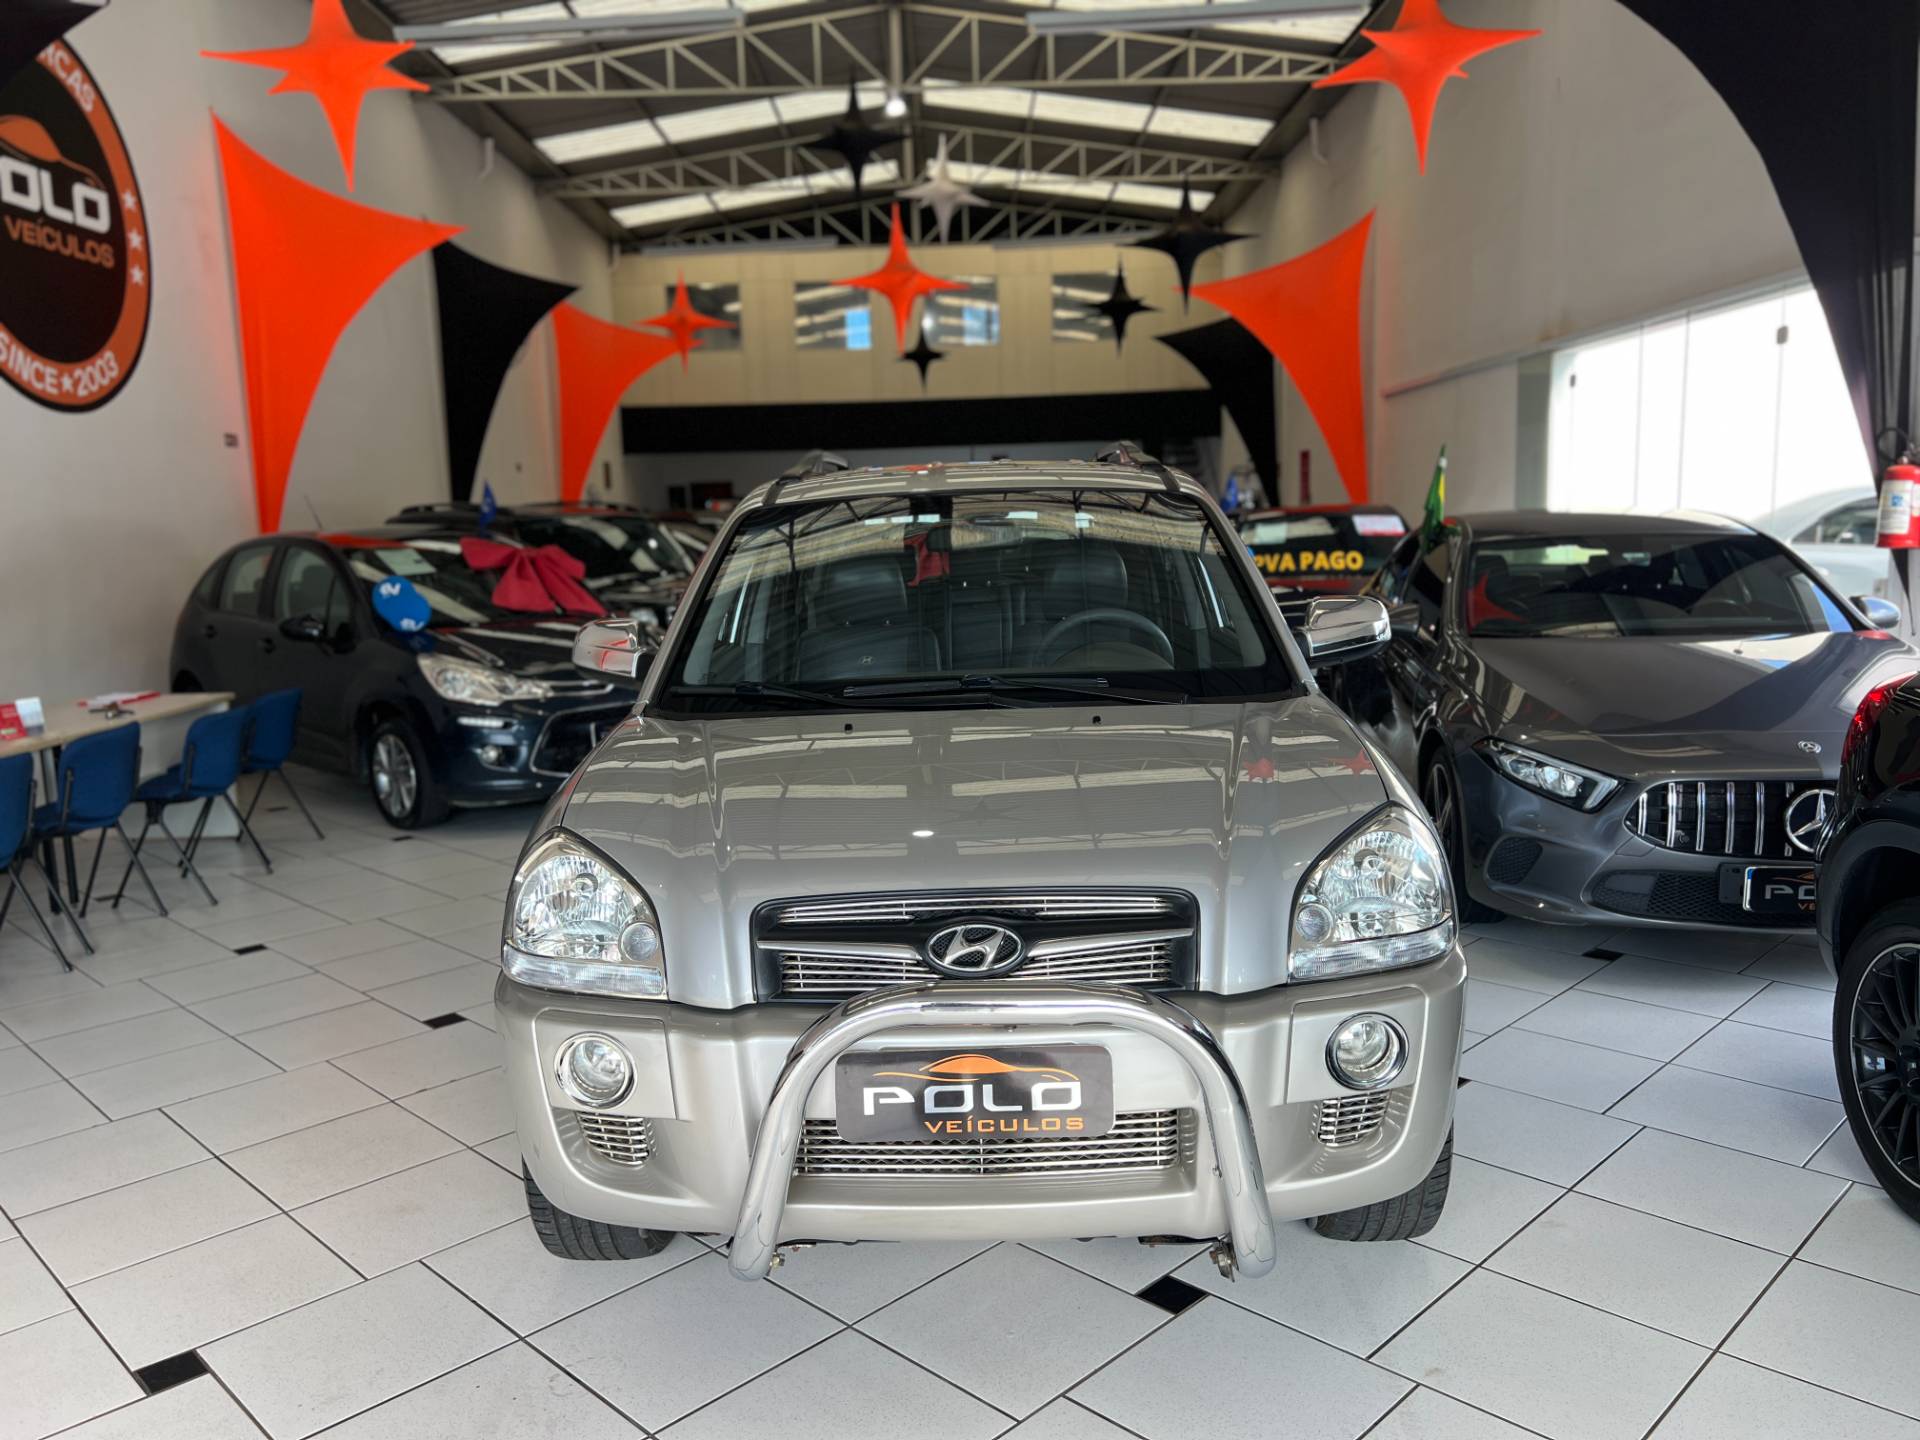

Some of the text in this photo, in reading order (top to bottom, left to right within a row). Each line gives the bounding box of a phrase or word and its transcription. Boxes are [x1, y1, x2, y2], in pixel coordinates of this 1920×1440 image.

[4, 215, 115, 269] VEÍCULOS
[0, 330, 119, 397] SINCE 2003
[1299, 550, 1364, 572] PAGO
[863, 1081, 1082, 1116] POLO
[923, 1115, 1085, 1135] VEÍCULOS
